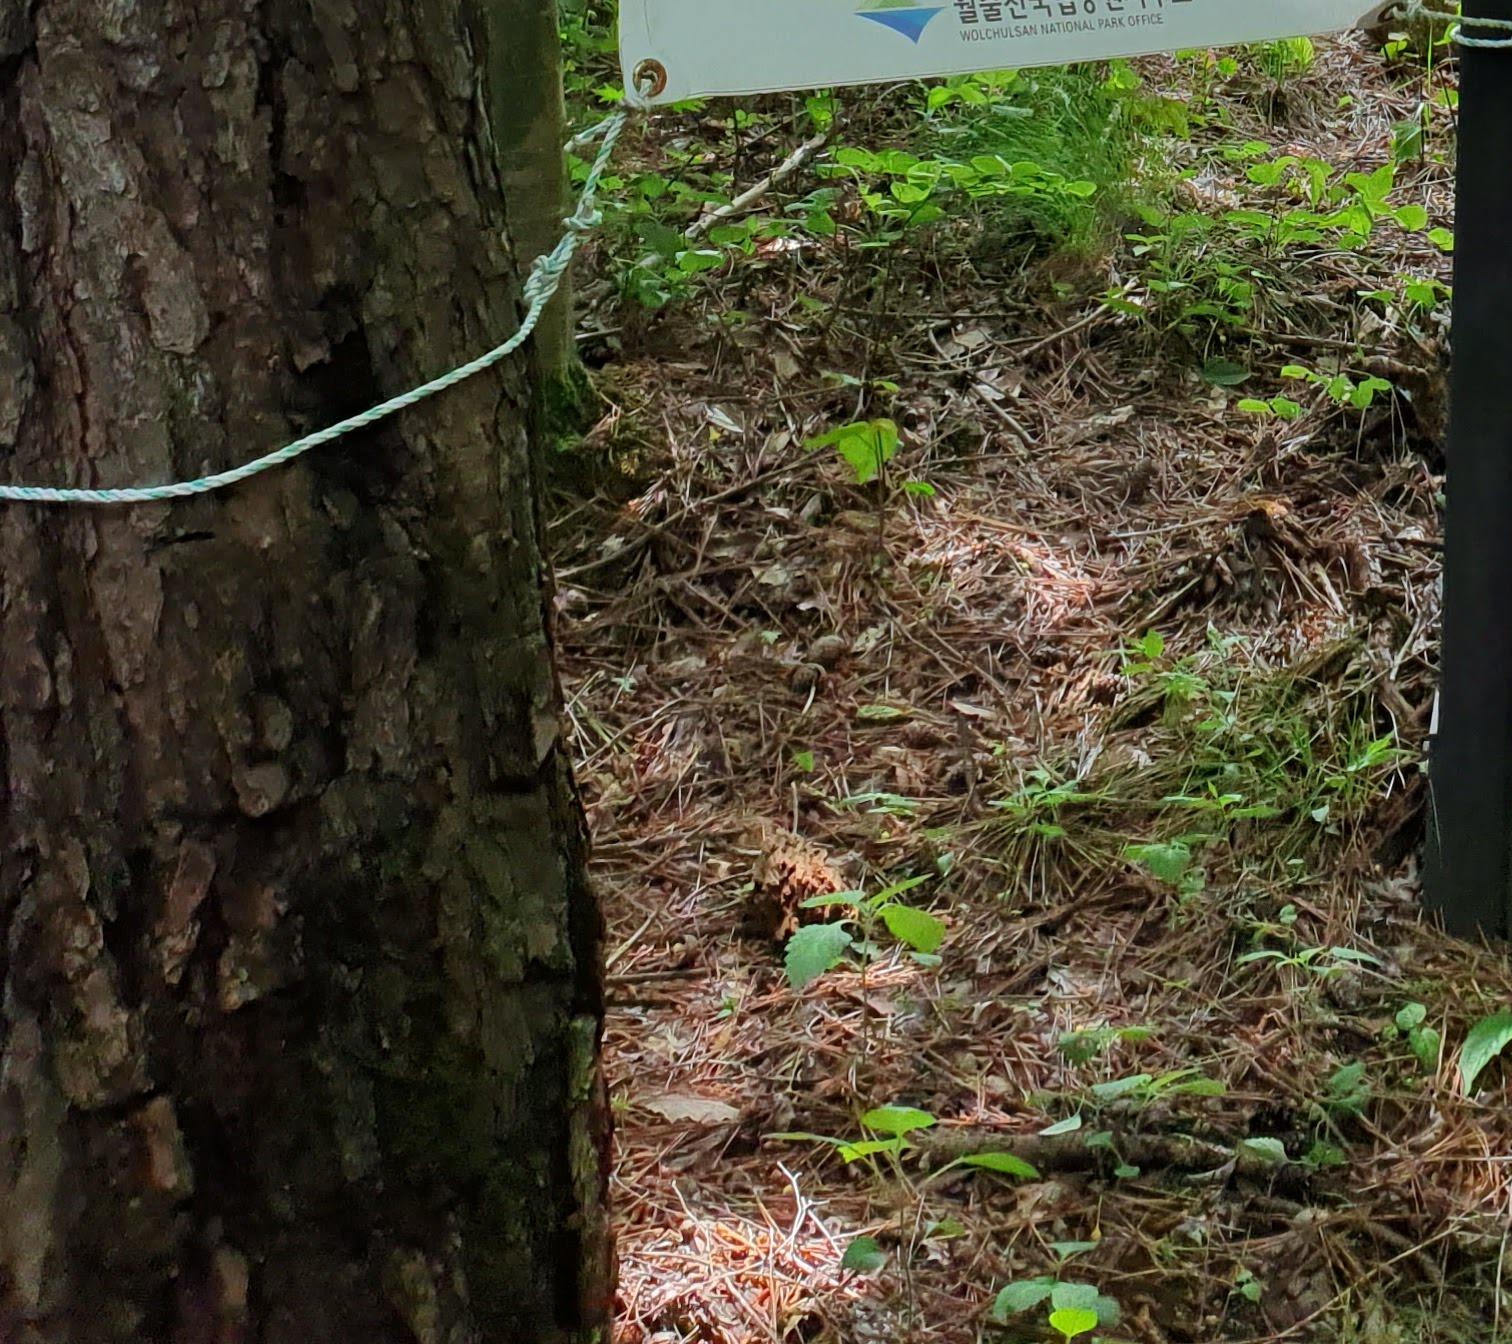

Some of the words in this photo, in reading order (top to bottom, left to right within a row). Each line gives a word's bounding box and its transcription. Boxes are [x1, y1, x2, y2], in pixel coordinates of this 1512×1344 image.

[960, 24, 1037, 41] WOLCHULSAN
[1041, 20, 1095, 34] NATIONAL
[1098, 17, 1125, 28] PARK
[1128, 13, 1163, 26] OFFICE
